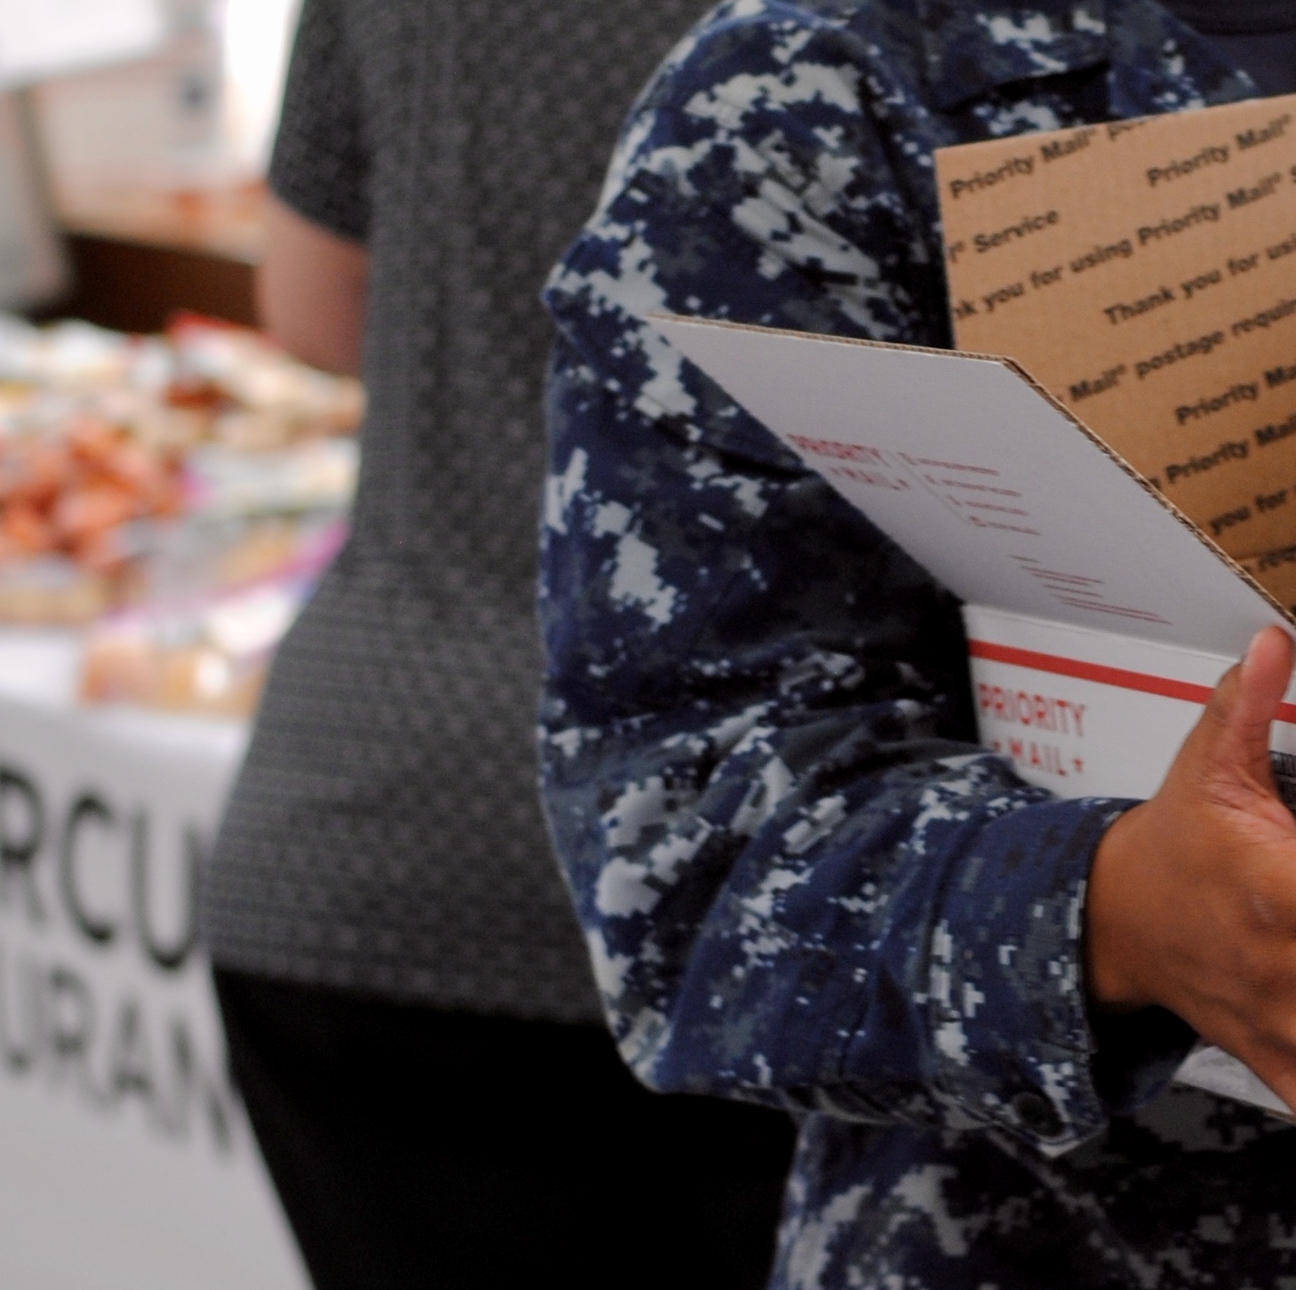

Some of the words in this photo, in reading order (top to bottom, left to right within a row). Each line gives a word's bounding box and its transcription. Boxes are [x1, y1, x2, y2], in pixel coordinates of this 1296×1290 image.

[949, 154, 1035, 199] Priority
[1146, 144, 1230, 187] Priority
[974, 210, 1059, 253] Service
[982, 282, 1024, 310] you
[1030, 264, 1064, 289] for
[1070, 240, 1133, 274] using
[1137, 204, 1221, 246] Priority
[1104, 286, 1175, 325] Thank
[1181, 269, 1221, 300] you
[1227, 254, 1260, 277] for
[1135, 330, 1225, 380] postage
[1174, 383, 1258, 425] Priority
[1165, 440, 1249, 484] Priority
[1210, 507, 1251, 536] you
[1255, 488, 1289, 510] for
[978, 682, 1086, 737] PRIORITY
[1008, 737, 1069, 777] MAIL
